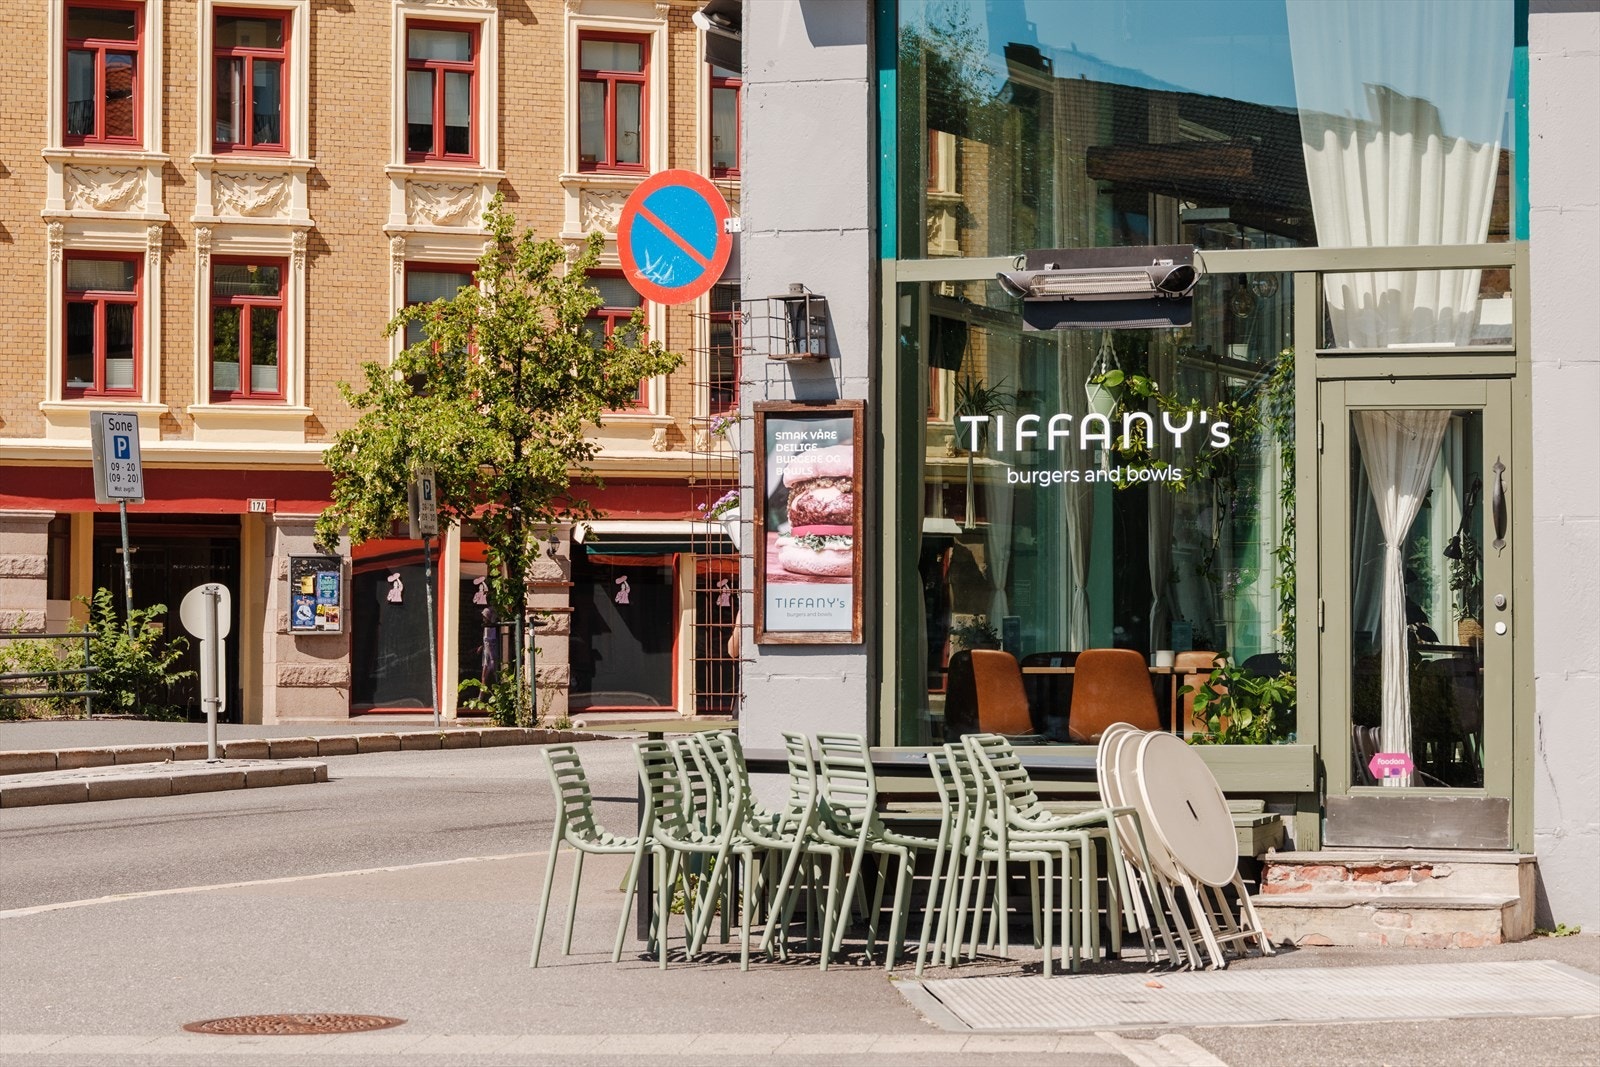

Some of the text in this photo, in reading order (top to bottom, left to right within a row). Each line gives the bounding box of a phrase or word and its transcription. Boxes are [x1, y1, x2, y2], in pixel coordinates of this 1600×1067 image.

[108, 417, 133, 432] Sone
[775, 428, 838, 440] SMAK VÅRE
[117, 437, 127, 457] P
[775, 443, 818, 452] DEILIGE
[776, 455, 841, 464] BURGERE OG
[110, 462, 120, 471] 09
[126, 462, 136, 472] 20
[776, 467, 814, 476] BOWLS
[1006, 464, 1183, 487] burgers and bowls
[252, 501, 265, 511] 174
